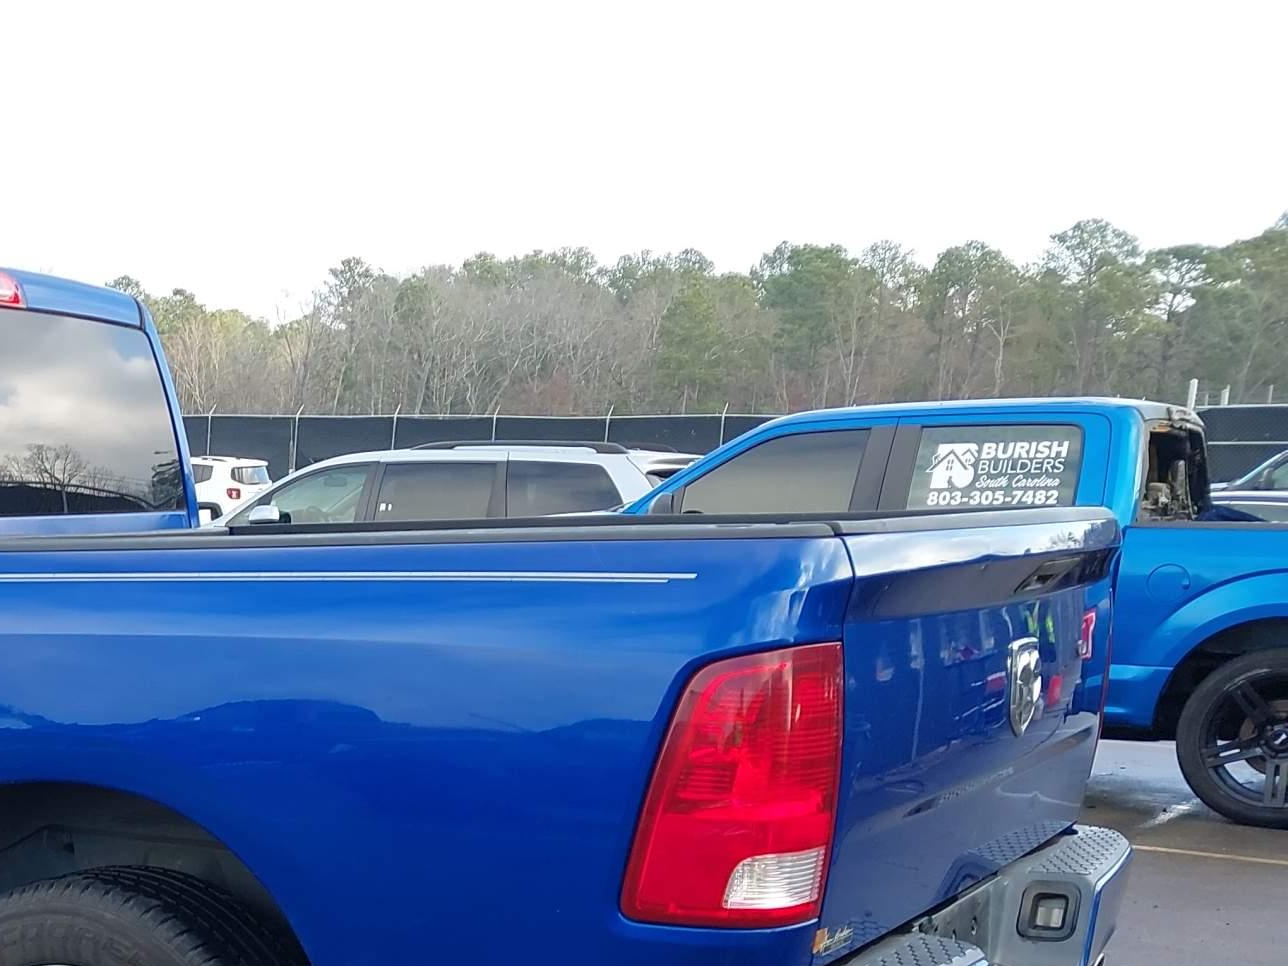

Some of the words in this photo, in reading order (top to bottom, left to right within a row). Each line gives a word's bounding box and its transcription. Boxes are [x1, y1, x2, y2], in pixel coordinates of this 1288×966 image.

[980, 440, 1069, 459] BURISH
[977, 458, 1065, 474] BUILDERS
[975, 475, 1009, 489] South
[1012, 474, 1061, 488] Carolina
[926, 489, 1059, 506] 803-305-7482
